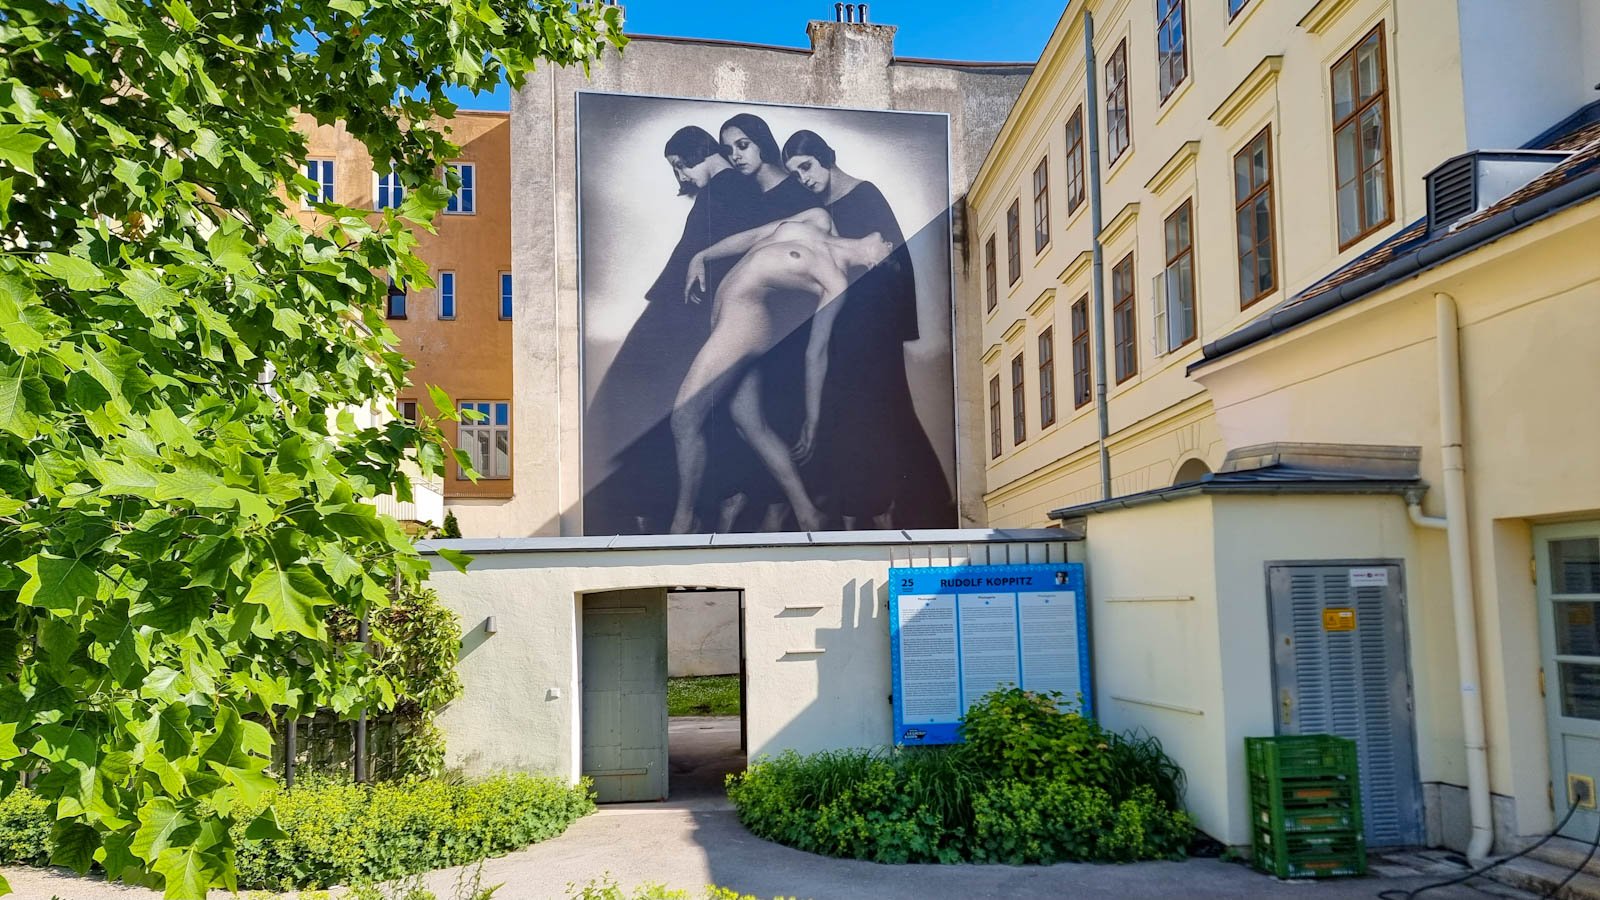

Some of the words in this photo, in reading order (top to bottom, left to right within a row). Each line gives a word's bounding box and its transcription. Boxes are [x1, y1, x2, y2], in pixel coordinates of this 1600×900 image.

[901, 578, 914, 587] 25
[940, 578, 983, 588] RUDOLF
[986, 577, 1033, 587] KOPPITZ
